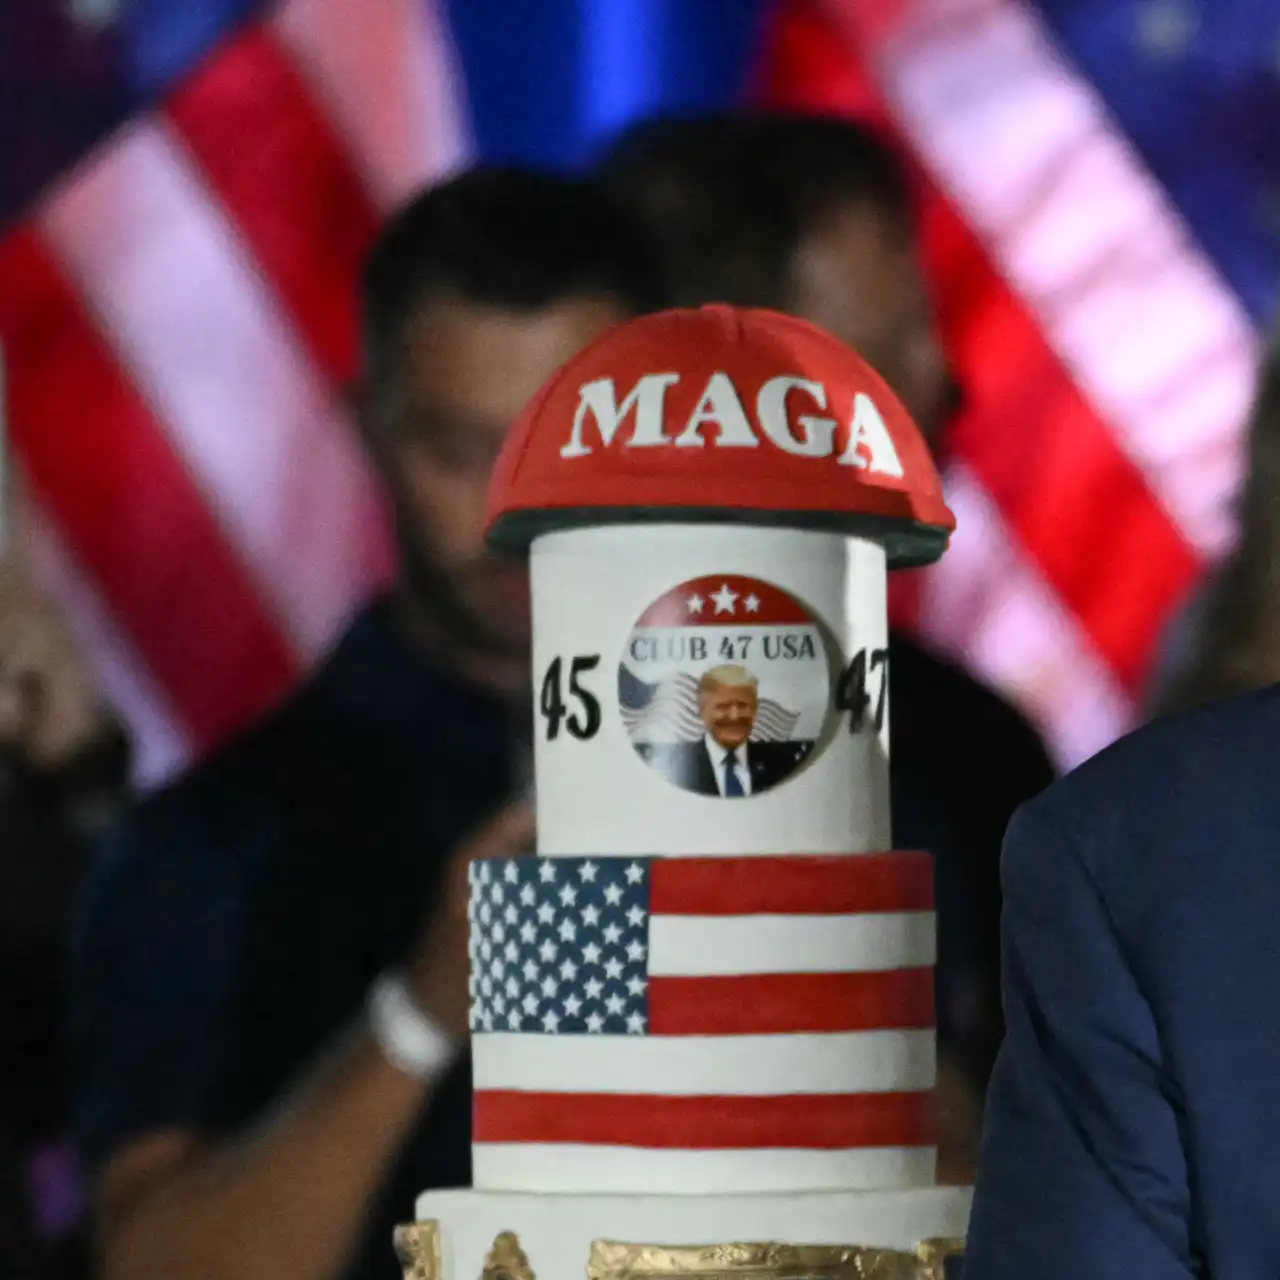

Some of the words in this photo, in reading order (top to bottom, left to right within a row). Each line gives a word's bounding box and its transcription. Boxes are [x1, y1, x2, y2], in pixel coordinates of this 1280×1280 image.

[560, 371, 904, 479] MAGA
[630, 636, 707, 662] CLUB
[719, 636, 752, 660] 47
[762, 634, 816, 661] USA
[836, 647, 889, 735] 47
[541, 653, 601, 741] 45
